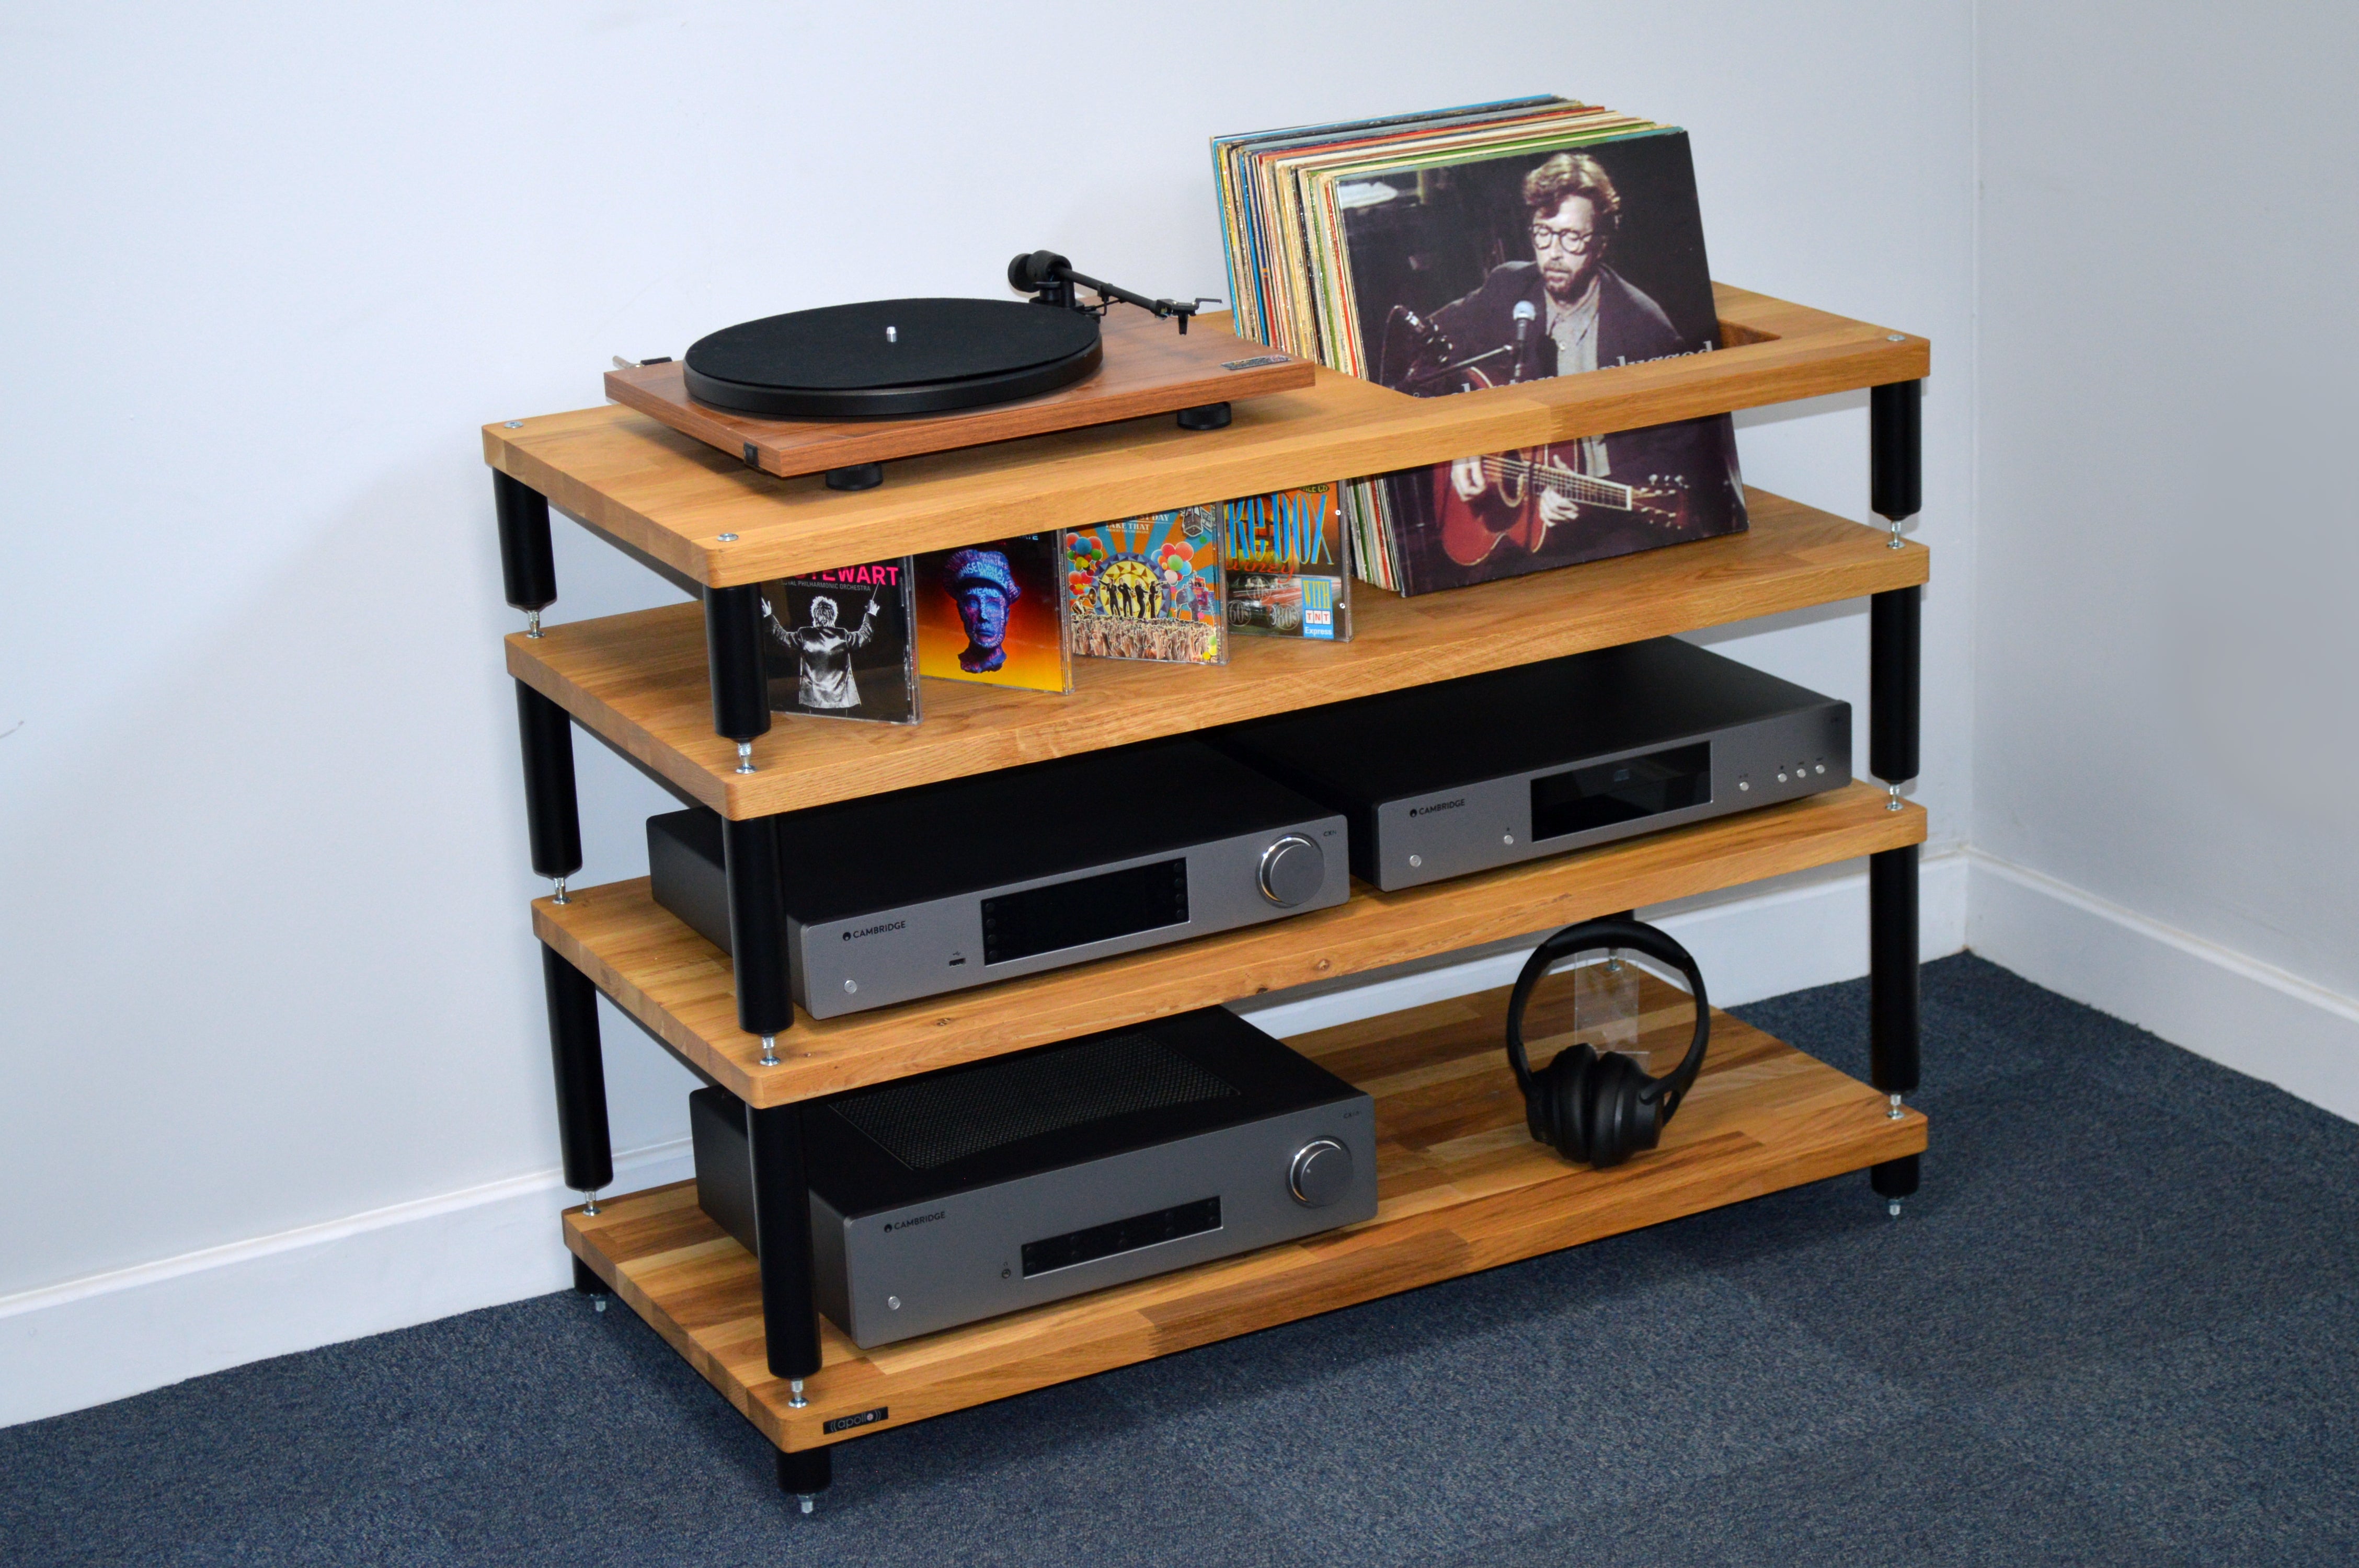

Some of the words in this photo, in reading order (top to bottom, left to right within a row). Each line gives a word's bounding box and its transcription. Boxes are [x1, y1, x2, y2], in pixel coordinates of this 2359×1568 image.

[795, 566, 898, 586] EWART
[1225, 561, 1296, 584] urney
[798, 581, 838, 589] PHILHARMONIC
[982, 587, 999, 598] AND
[1303, 580, 1331, 609] WITH
[1229, 605, 1249, 623] 60s
[1276, 607, 1297, 627] 80s
[1307, 612, 1329, 622] TNT
[1305, 627, 1332, 636] Express
[1418, 799, 1465, 815] CAMBRIDGE
[853, 920, 906, 938] CAMBRIDGE
[894, 1211, 945, 1230] CAMBRIDGE
